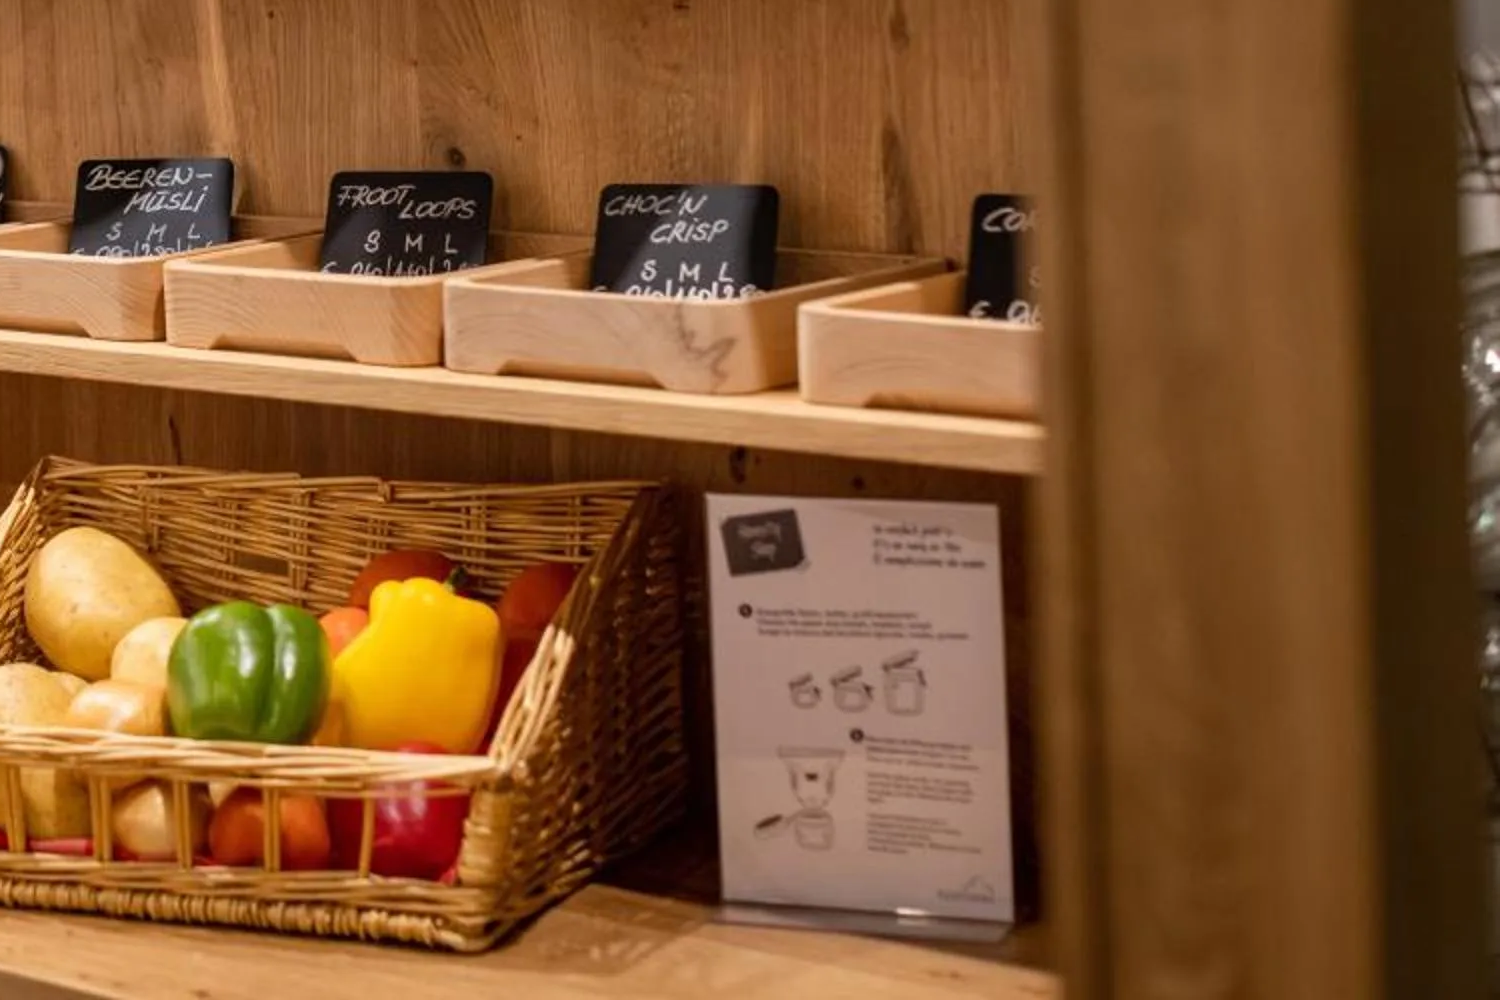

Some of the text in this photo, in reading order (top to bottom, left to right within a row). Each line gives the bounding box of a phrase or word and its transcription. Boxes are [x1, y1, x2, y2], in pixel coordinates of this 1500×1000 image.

[85, 164, 213, 190] BEEREN-
[123, 185, 209, 215] MÜSLI
[336, 184, 479, 220] FROOT LOOPS
[105, 222, 201, 242] S M L
[363, 229, 458, 254] S M L
[640, 259, 734, 283] S M L
